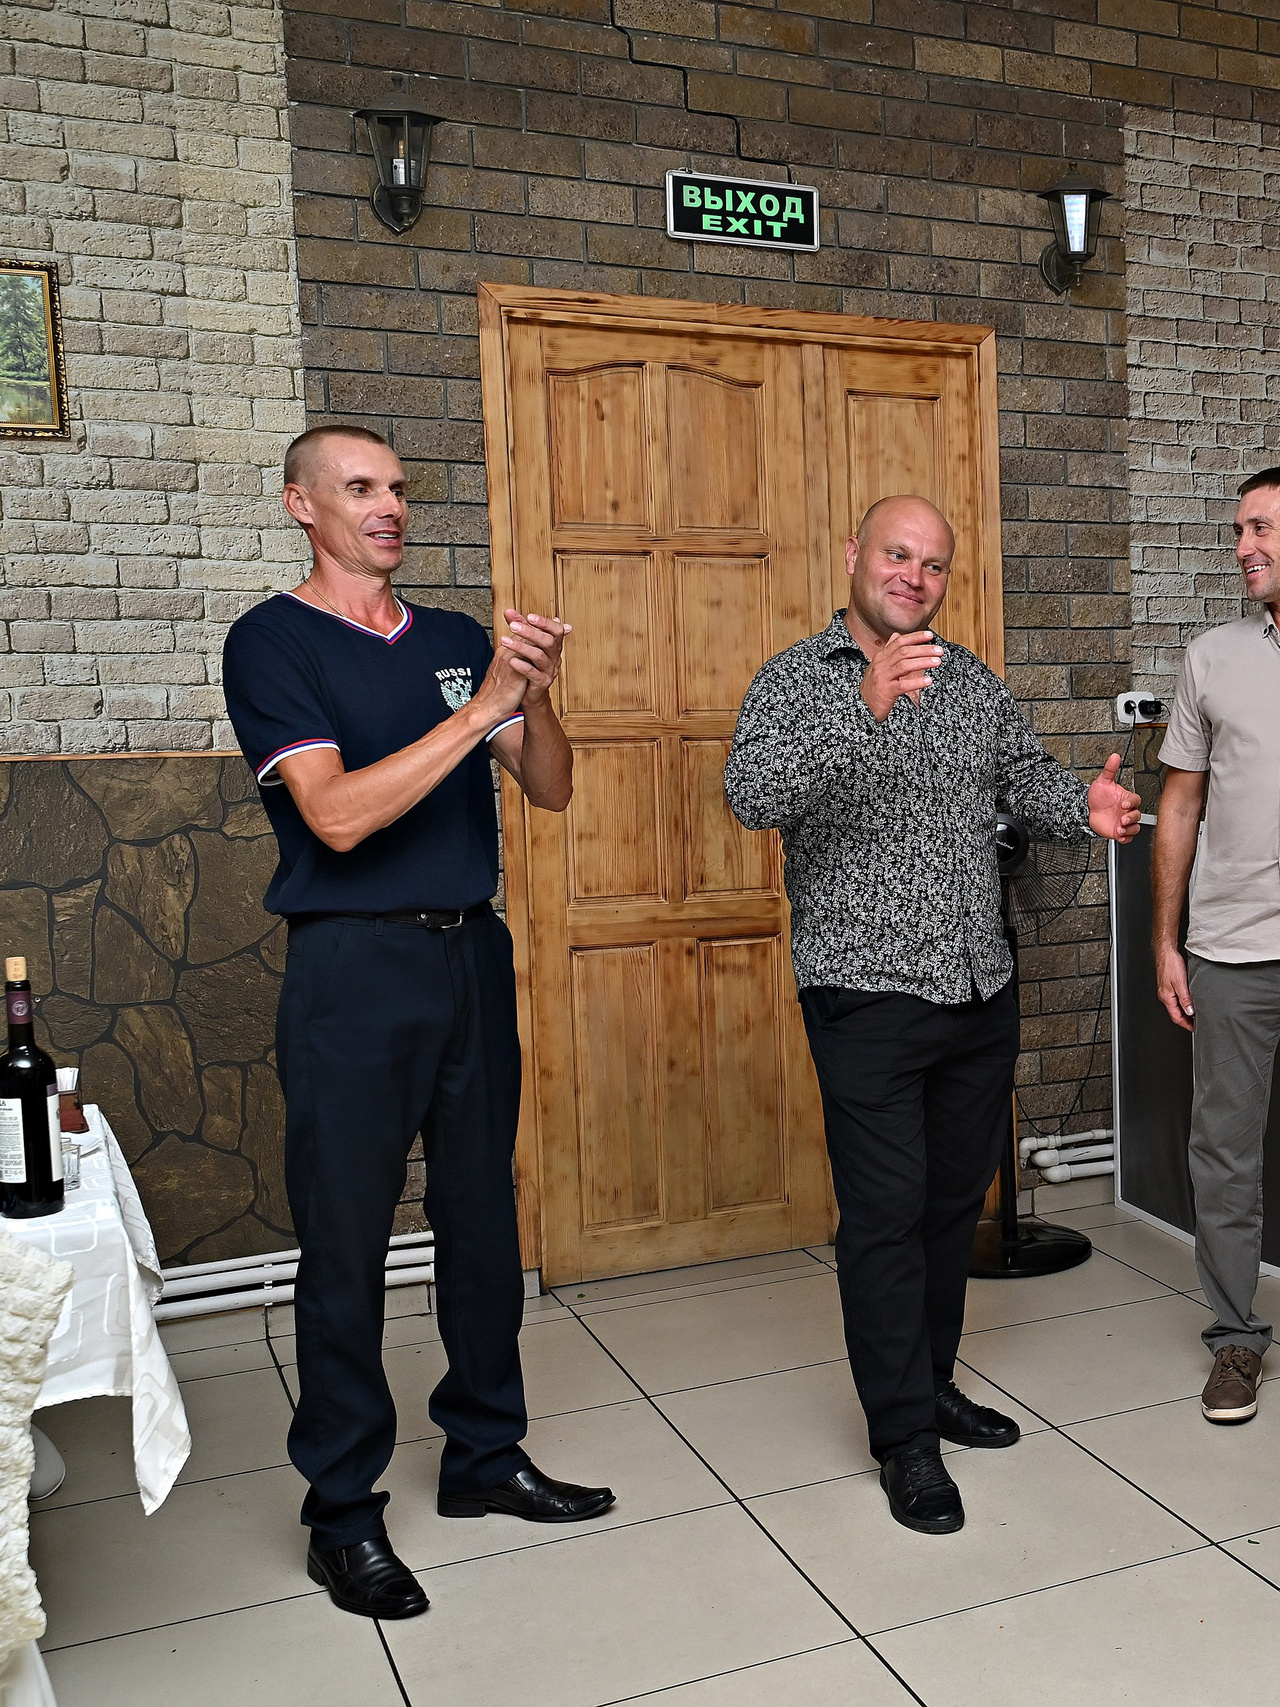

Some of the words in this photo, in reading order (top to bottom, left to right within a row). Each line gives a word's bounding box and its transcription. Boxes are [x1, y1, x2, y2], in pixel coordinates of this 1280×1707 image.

[682, 184, 805, 224] ВЫХОД
[702, 213, 789, 238] EXIT
[434, 667, 472, 681] RUSSI
